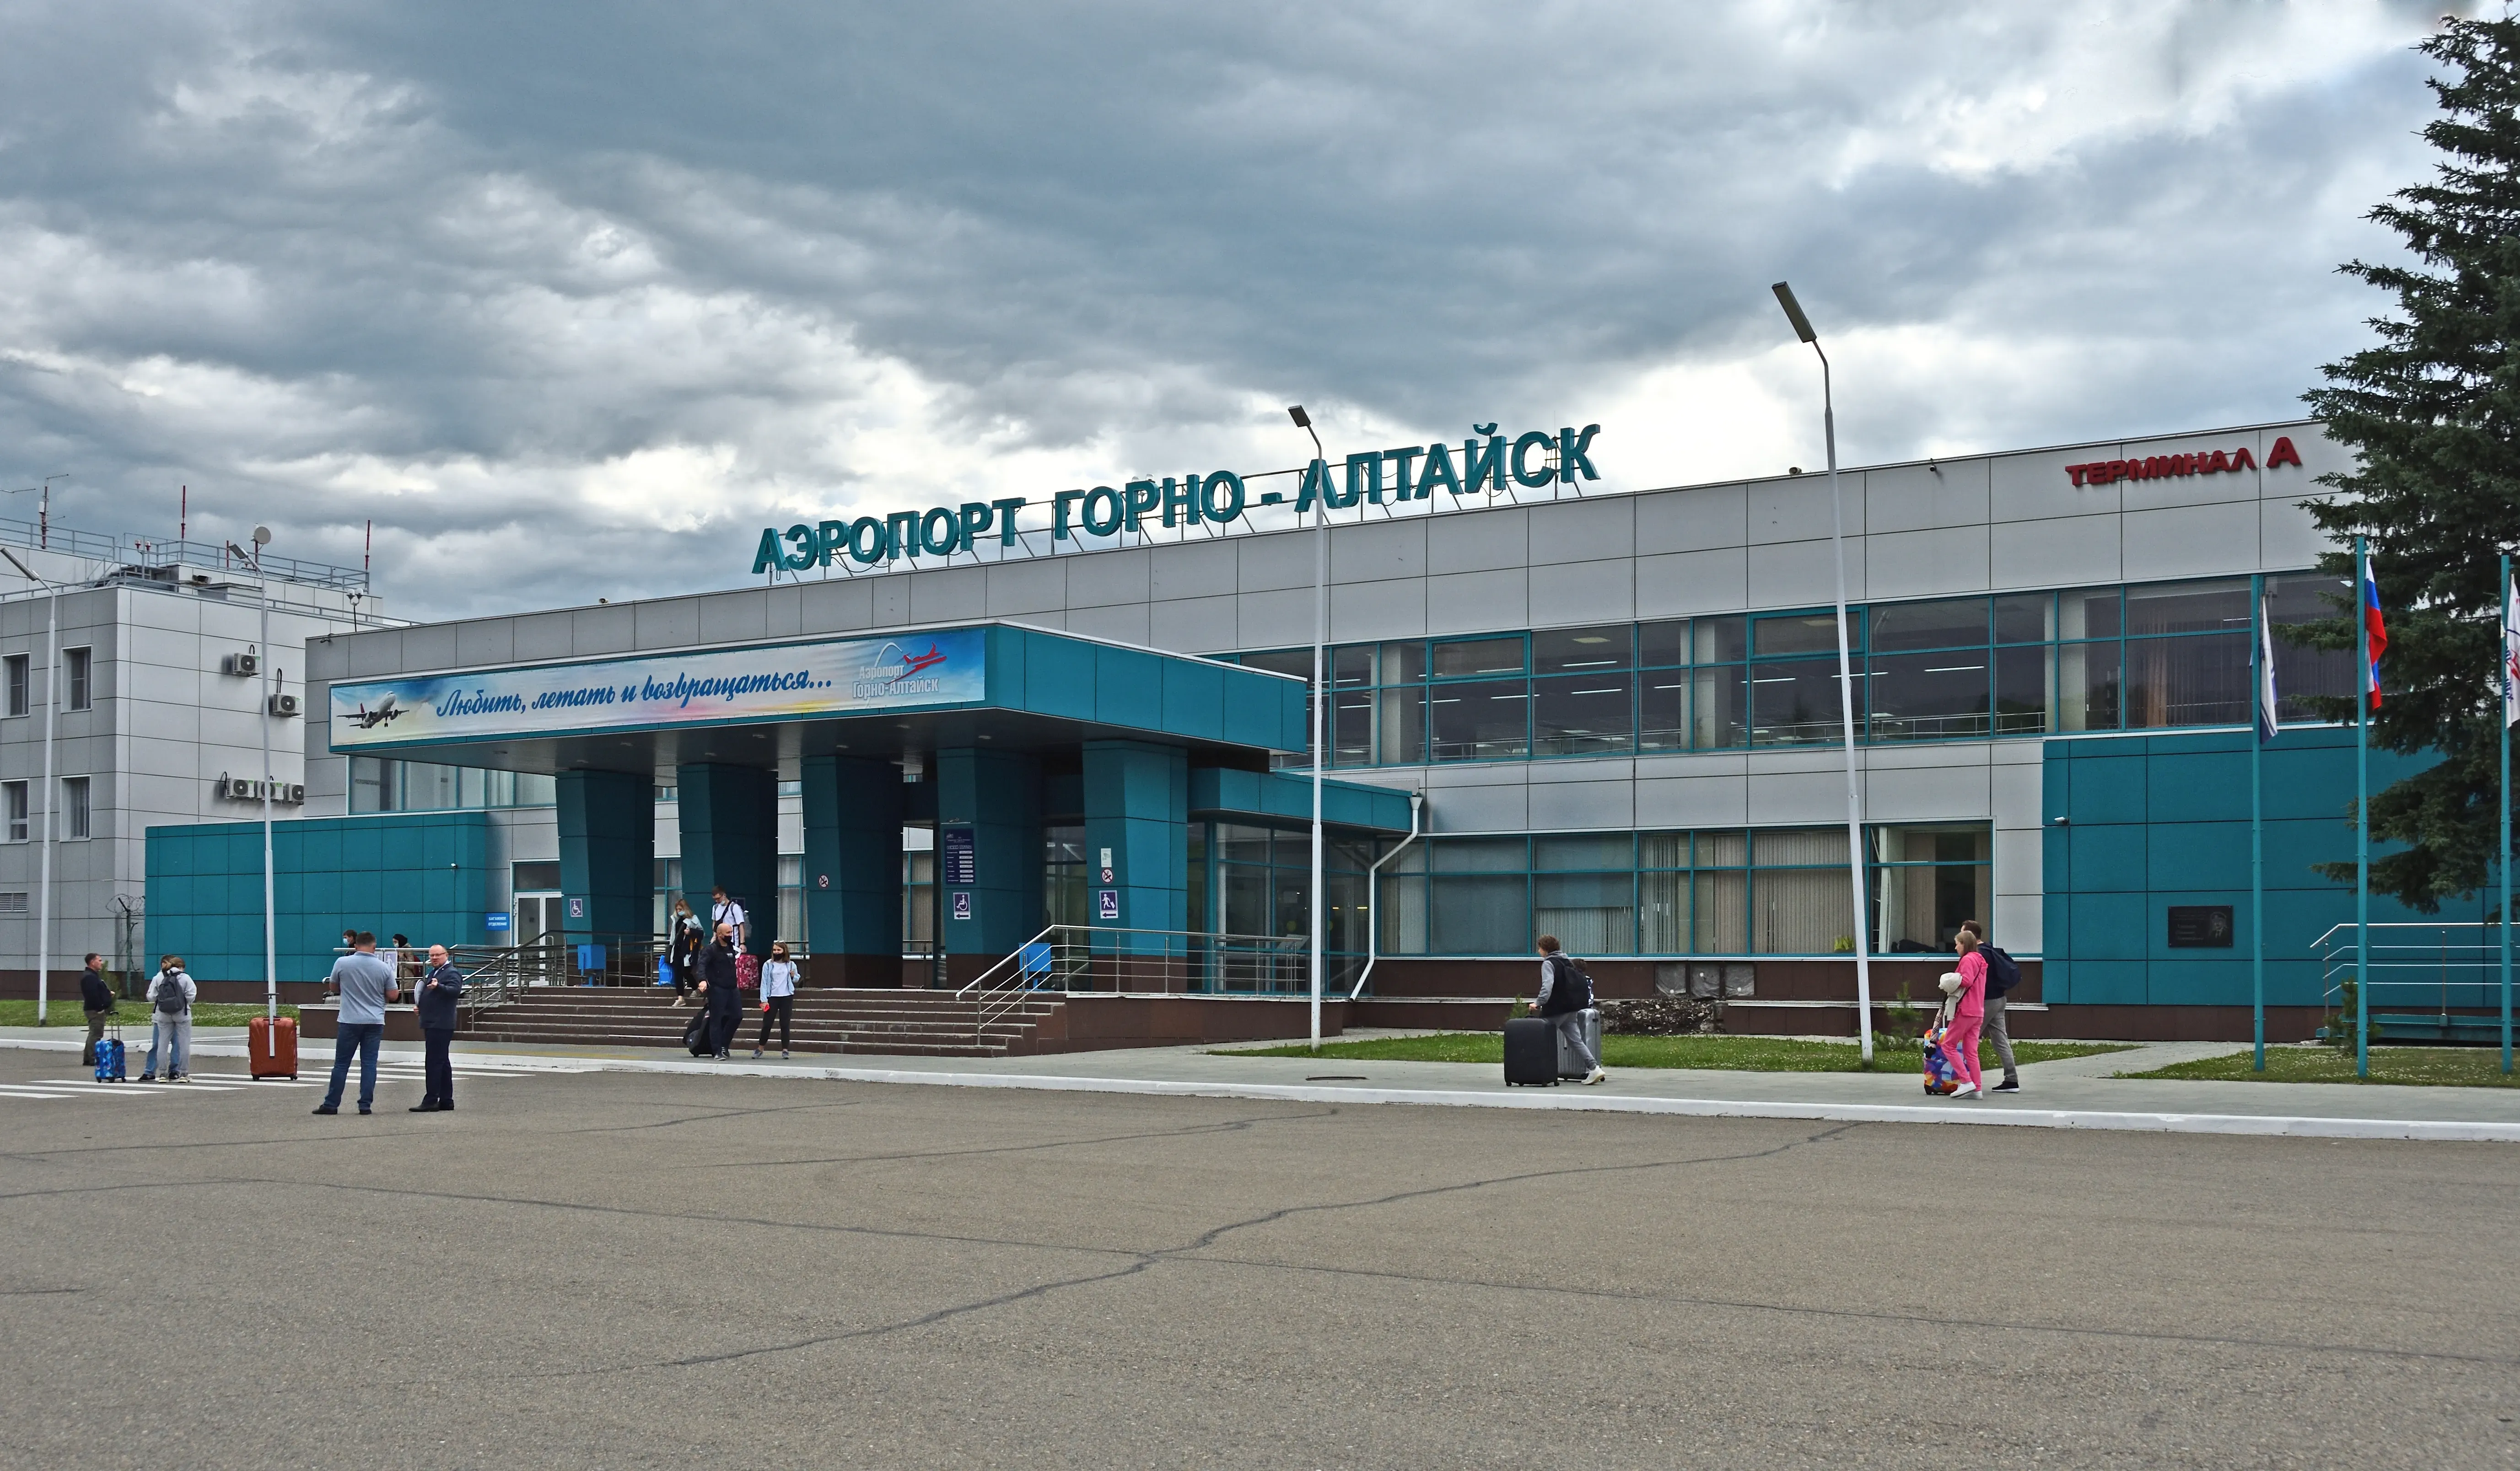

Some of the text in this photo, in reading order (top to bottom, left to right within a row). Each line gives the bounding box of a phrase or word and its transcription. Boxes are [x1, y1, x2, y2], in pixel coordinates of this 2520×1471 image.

[2065, 437, 2303, 486] ТЕРМИНАЛ А
[752, 497, 1026, 574] АЭРОПОРТ
[1055, 470, 1245, 540] ГОРНО
[1294, 423, 1601, 512] АЛТАЙСК
[436, 670, 831, 716] Любить, летать и возвращаться...
[853, 675, 938, 700] Горно-Алтайск
[859, 665, 905, 680] Аэропорт
